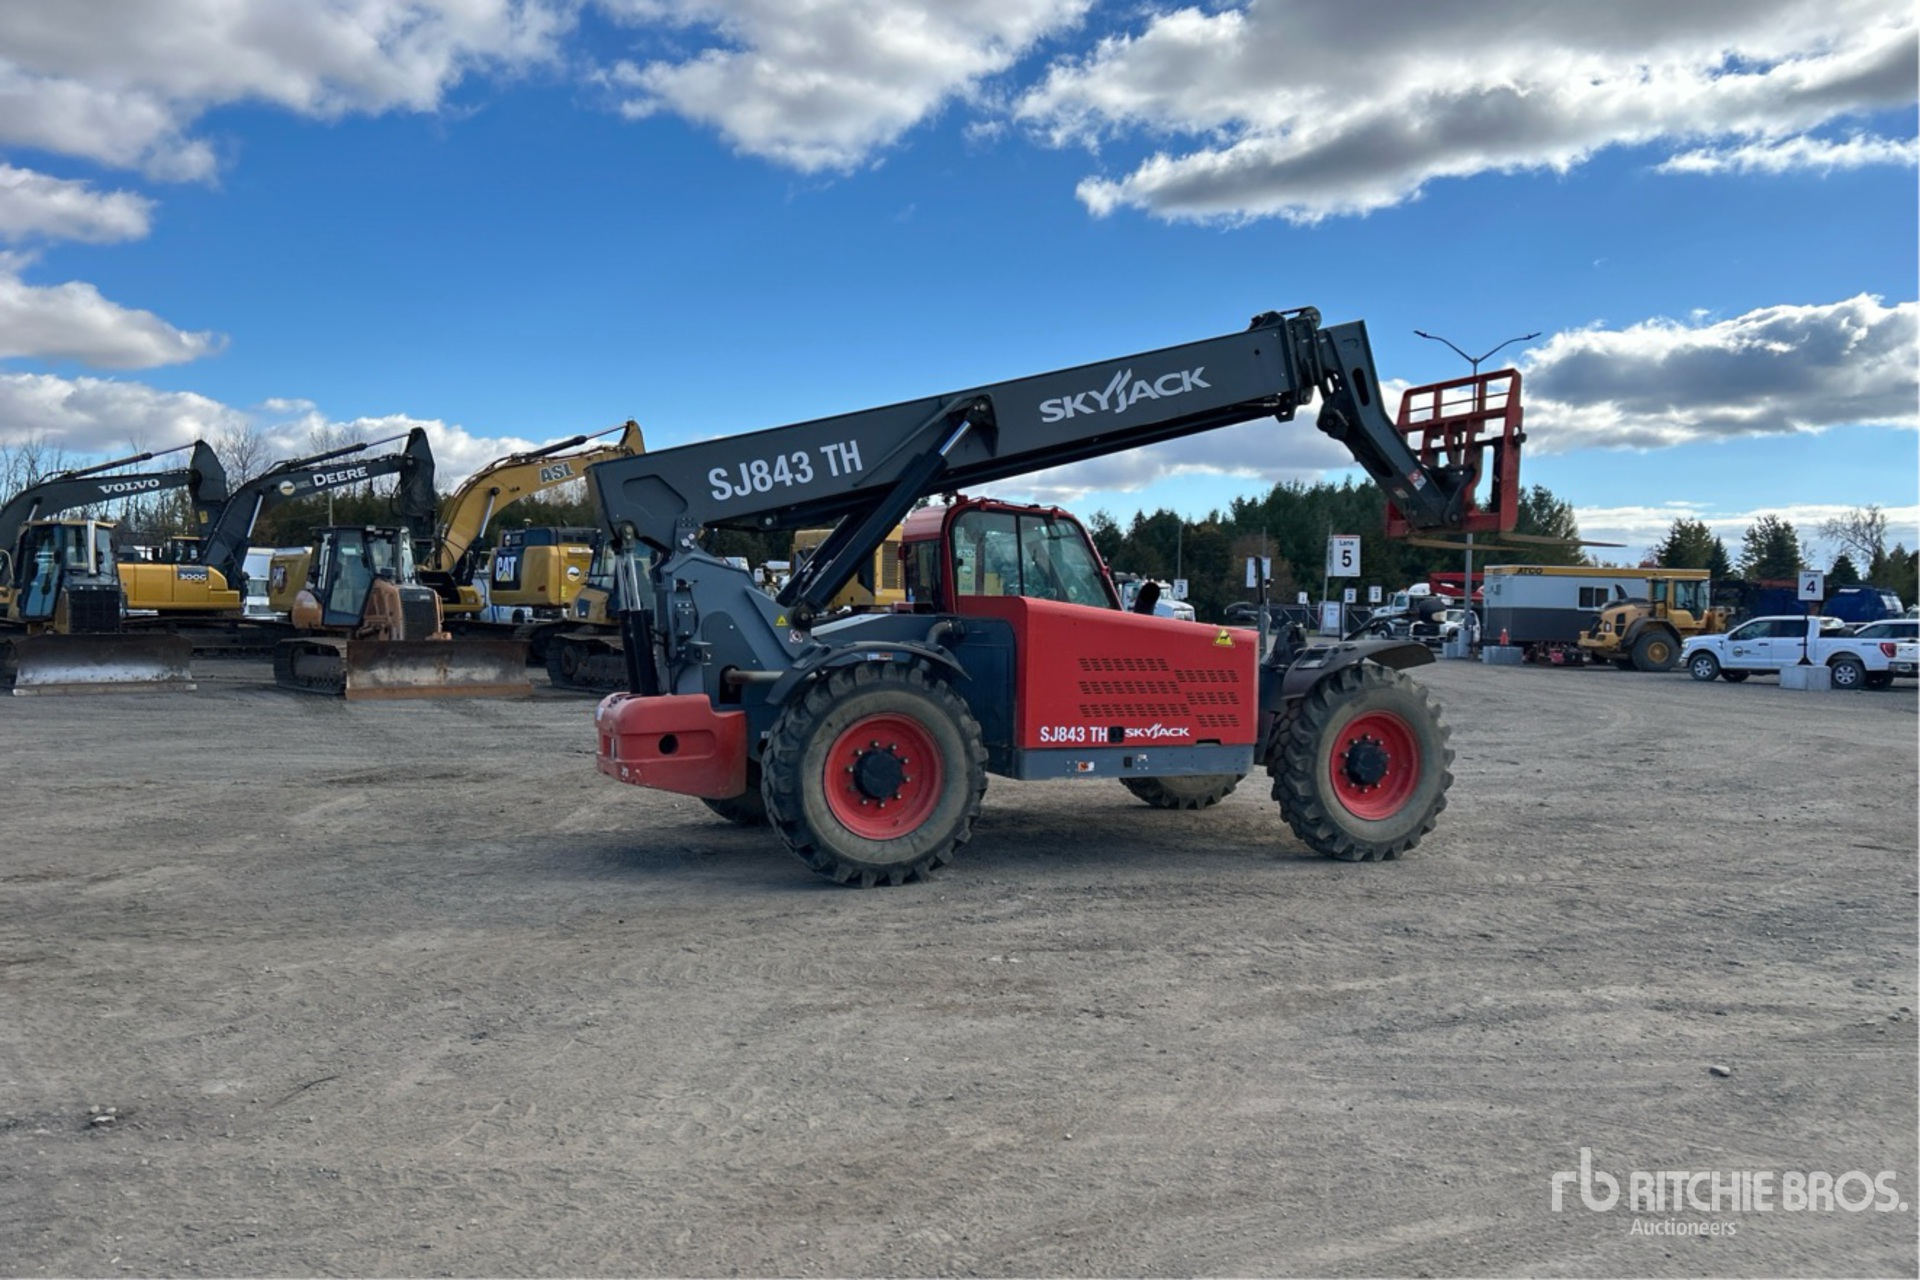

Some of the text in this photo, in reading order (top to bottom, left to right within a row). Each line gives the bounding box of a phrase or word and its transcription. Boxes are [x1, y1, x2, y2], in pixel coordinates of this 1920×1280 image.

[1039, 366, 1212, 423] SKYJACK
[313, 466, 368, 487] DEERE
[539, 461, 575, 484] ASL
[708, 440, 863, 501] SJ843 TH
[98, 479, 160, 494] VOLVO
[1342, 549, 1352, 568] 5
[495, 557, 517, 581] CAT
[1515, 567, 1543, 576] ATCO
[1178, 584, 1184, 593] 3
[1805, 580, 1816, 594] 4
[1040, 726, 1108, 742] SJ843 TH
[1125, 723, 1190, 739] SKYJACK
